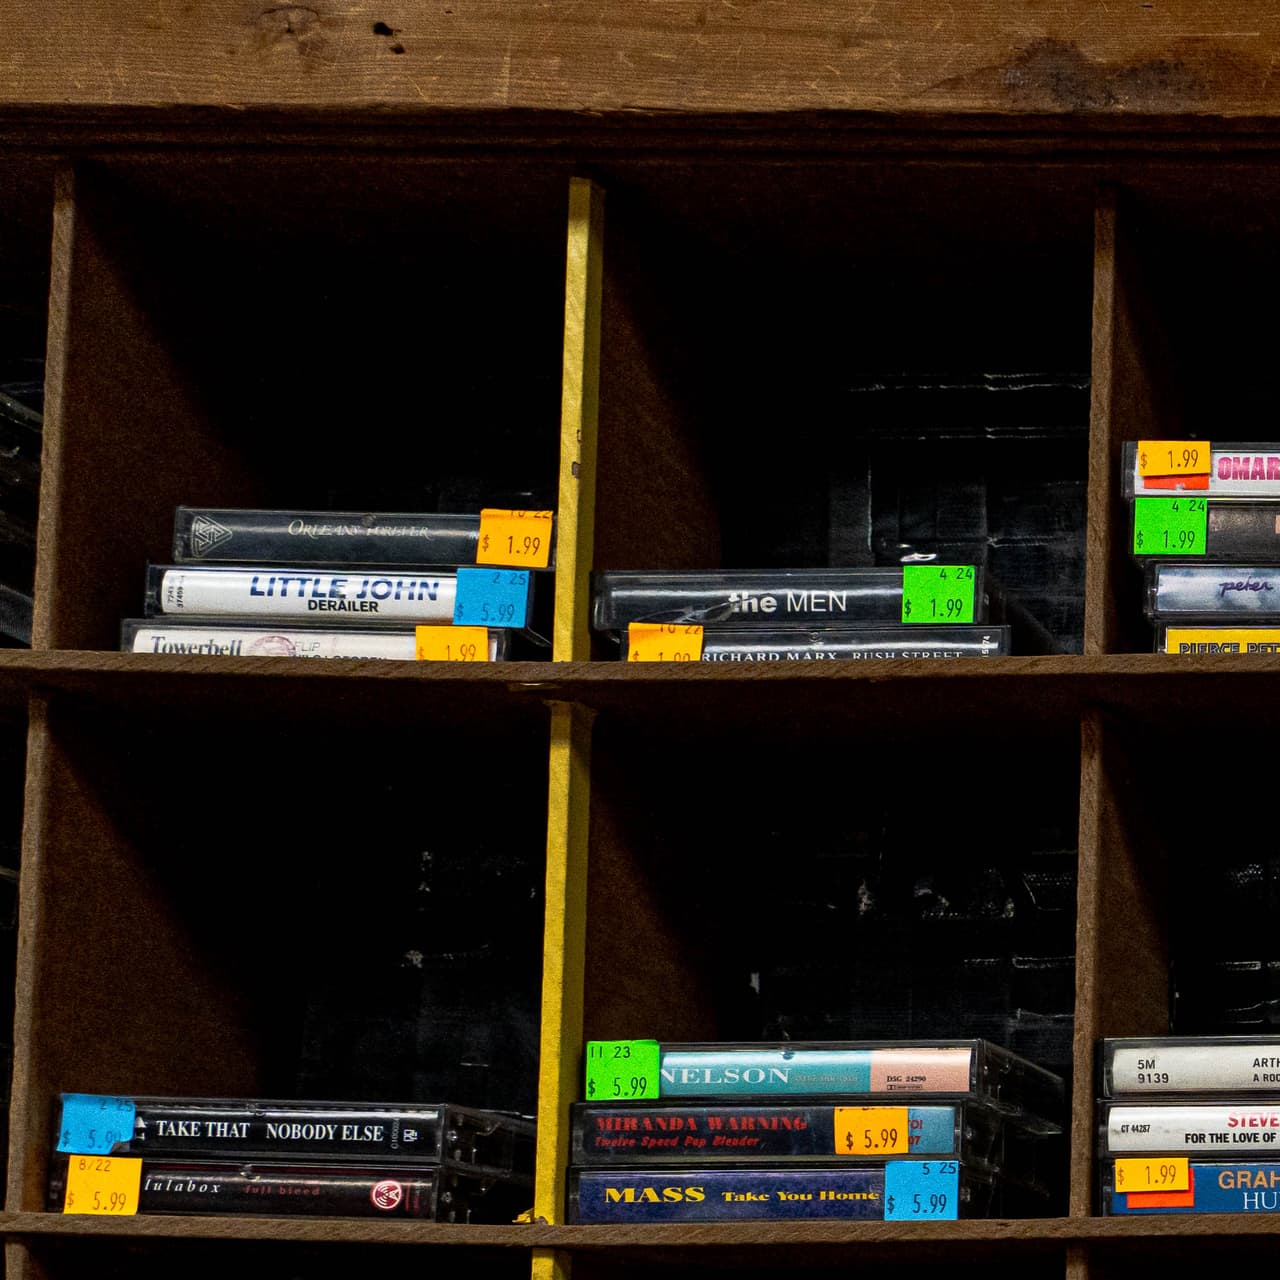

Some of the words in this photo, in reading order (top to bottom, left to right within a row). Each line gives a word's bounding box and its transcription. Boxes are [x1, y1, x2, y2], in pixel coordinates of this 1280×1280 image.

[1217, 457, 1280, 481] OMAR
[507, 535, 540, 554] 1.99
[250, 576, 348, 600] LITTLE
[356, 579, 439, 600] JOHN
[307, 600, 379, 613] DERAILER
[729, 594, 777, 613] the
[787, 591, 847, 612] MEN
[156, 1120, 200, 1137] TAKE
[205, 1122, 249, 1138] THAT
[266, 1123, 337, 1140] NOBODY
[341, 1125, 384, 1142] ELSE
[1185, 1134, 1206, 1143] FOR
[1209, 1133, 1229, 1143] THE
[1232, 1133, 1259, 1143] LOVE
[1263, 1133, 1275, 1142] OF
[605, 1187, 706, 1204] MASS
[721, 1191, 770, 1202] Take
[776, 1191, 813, 1202] You
[820, 1191, 880, 1201] Home
